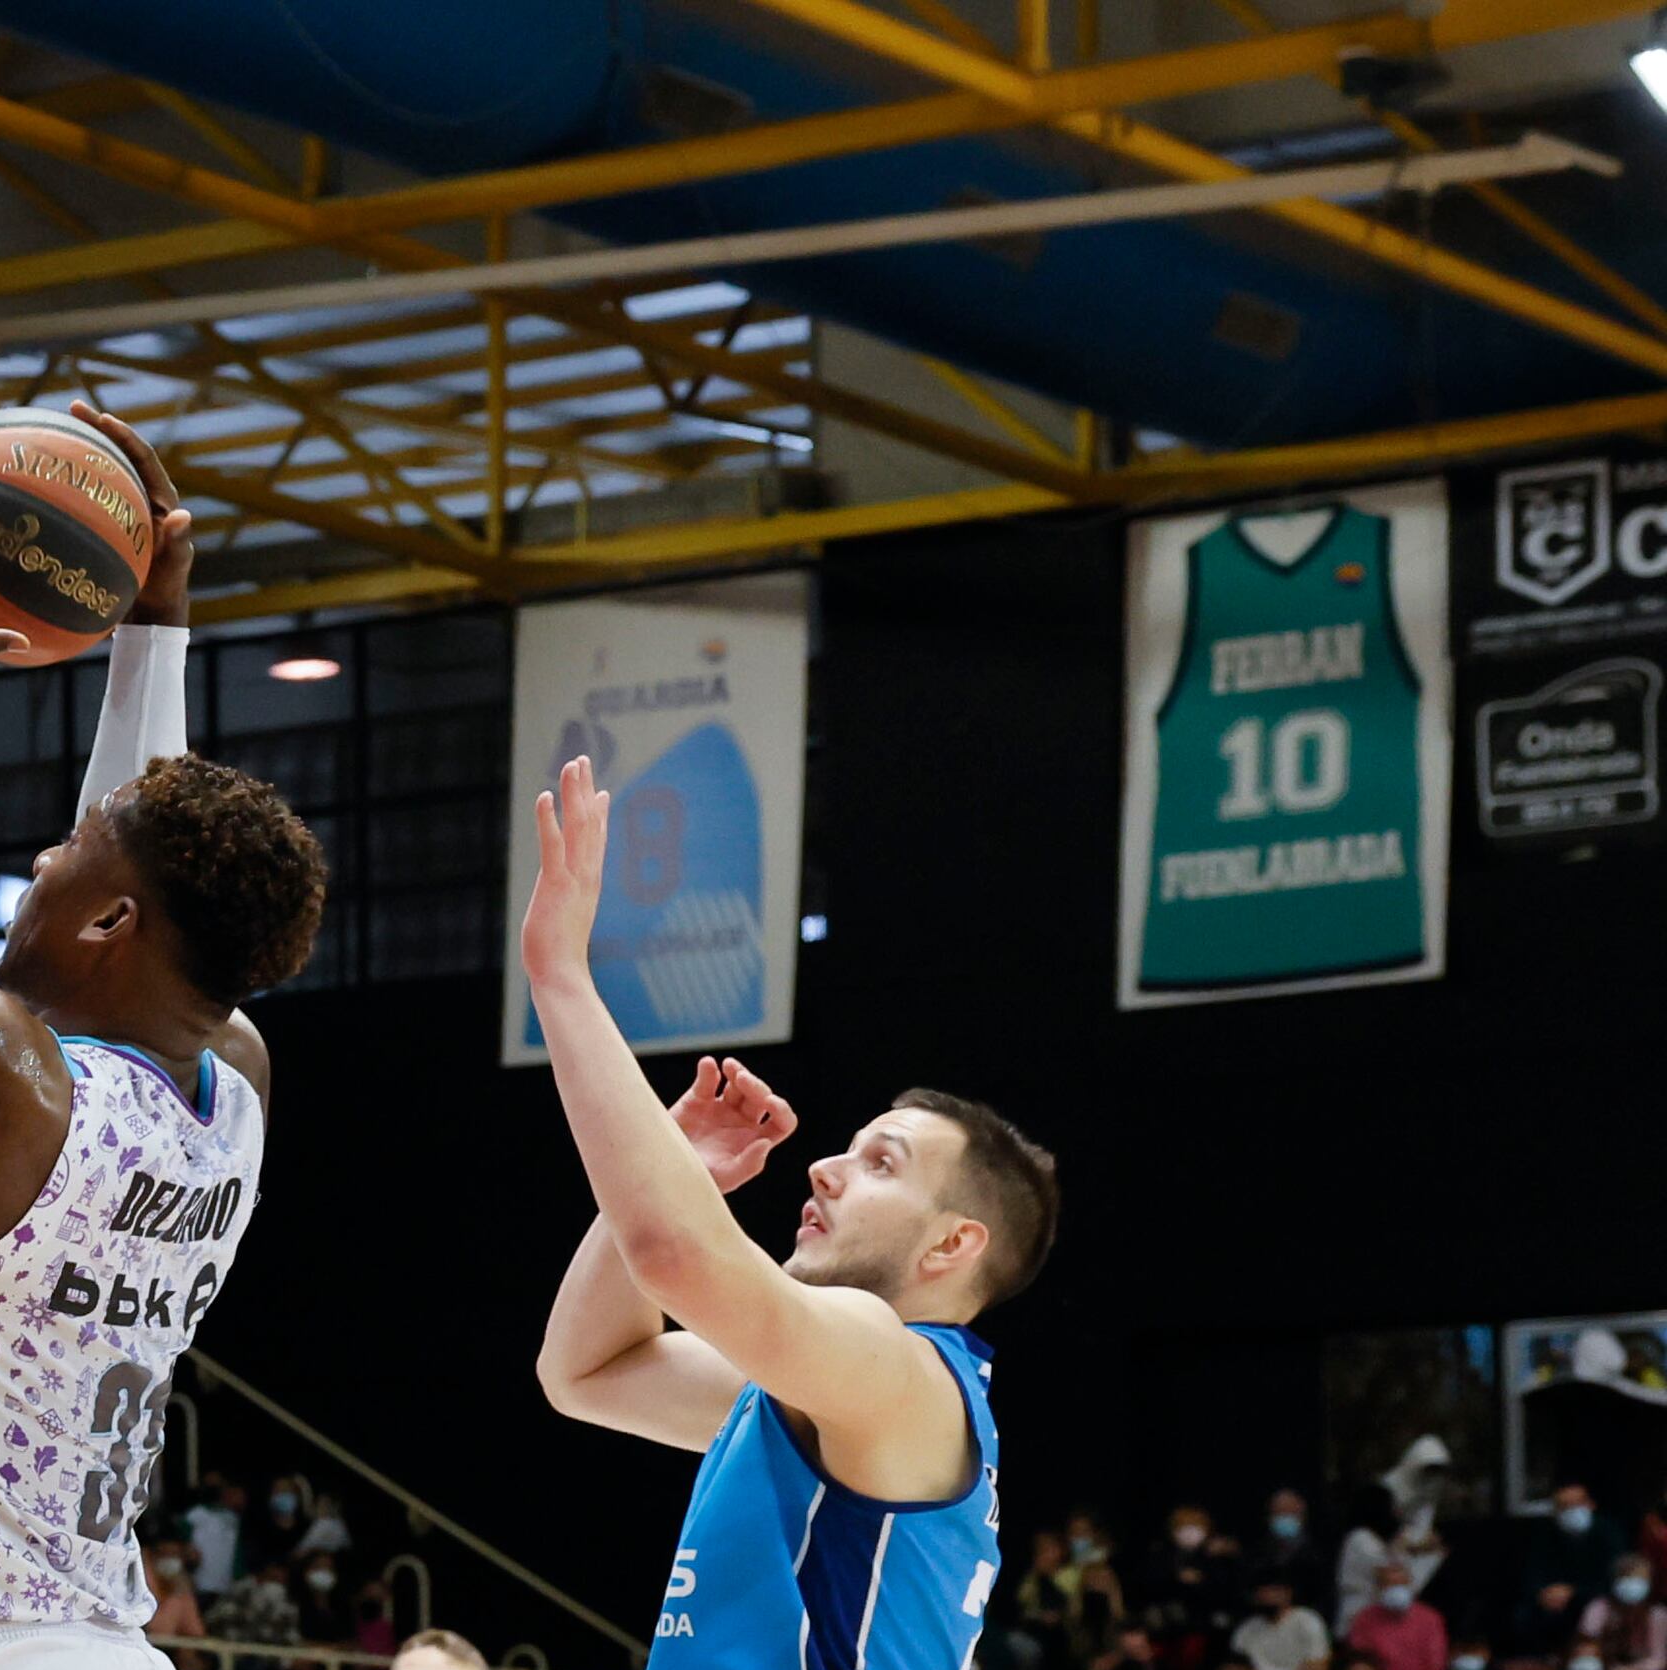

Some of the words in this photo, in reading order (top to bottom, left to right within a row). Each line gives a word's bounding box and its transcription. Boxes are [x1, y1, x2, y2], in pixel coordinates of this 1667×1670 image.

[19, 545, 120, 618] endesa
[1218, 709, 1350, 821] 10
[48, 1261, 175, 1328] bbk
